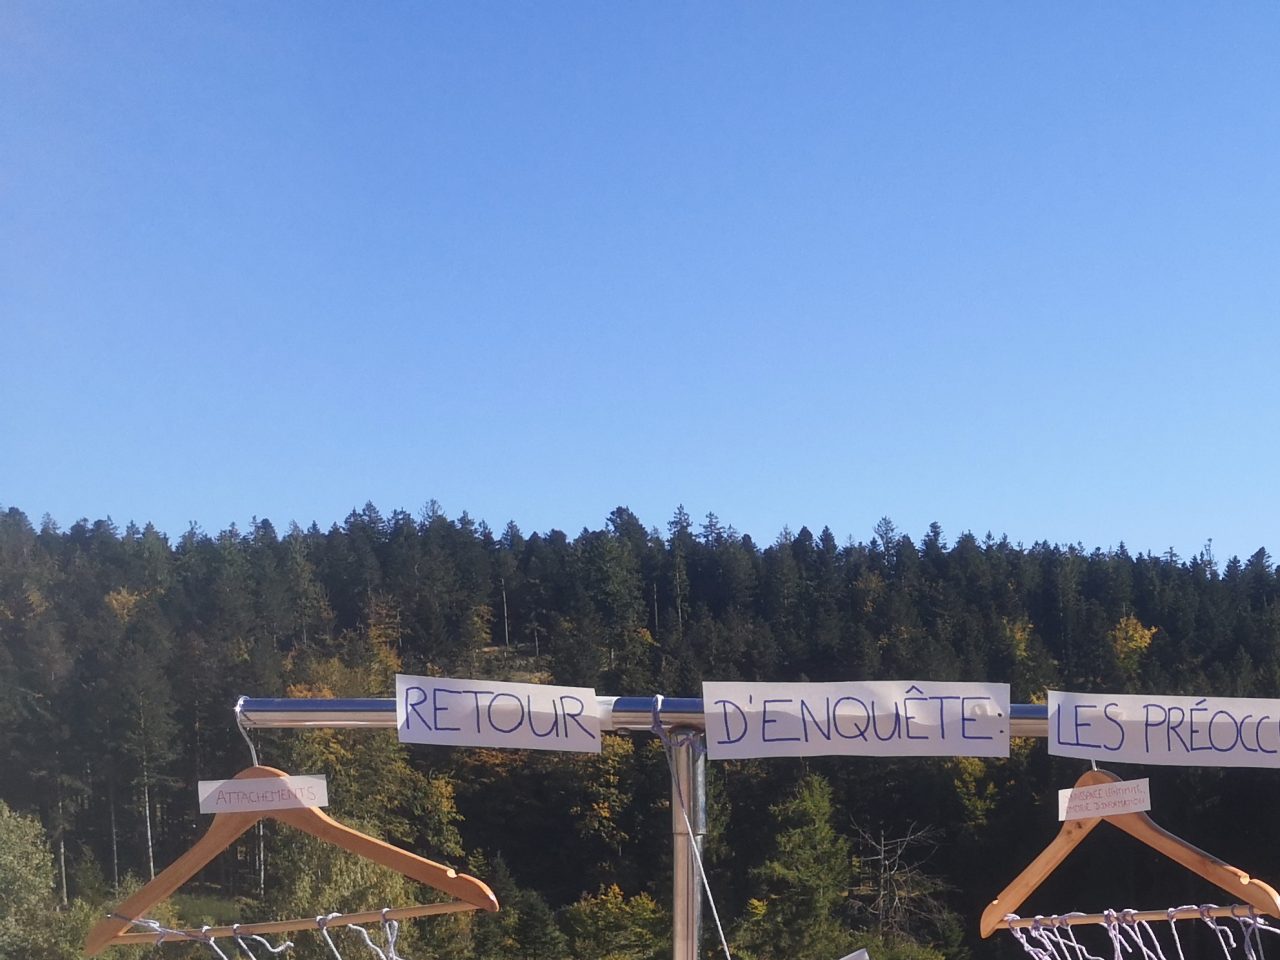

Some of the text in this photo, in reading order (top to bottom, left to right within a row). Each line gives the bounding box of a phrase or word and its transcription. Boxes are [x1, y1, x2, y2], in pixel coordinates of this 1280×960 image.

[404, 686, 597, 740] RETOUR
[1057, 702, 1125, 752] LES
[215, 786, 317, 806] ATTACHEMENTS
